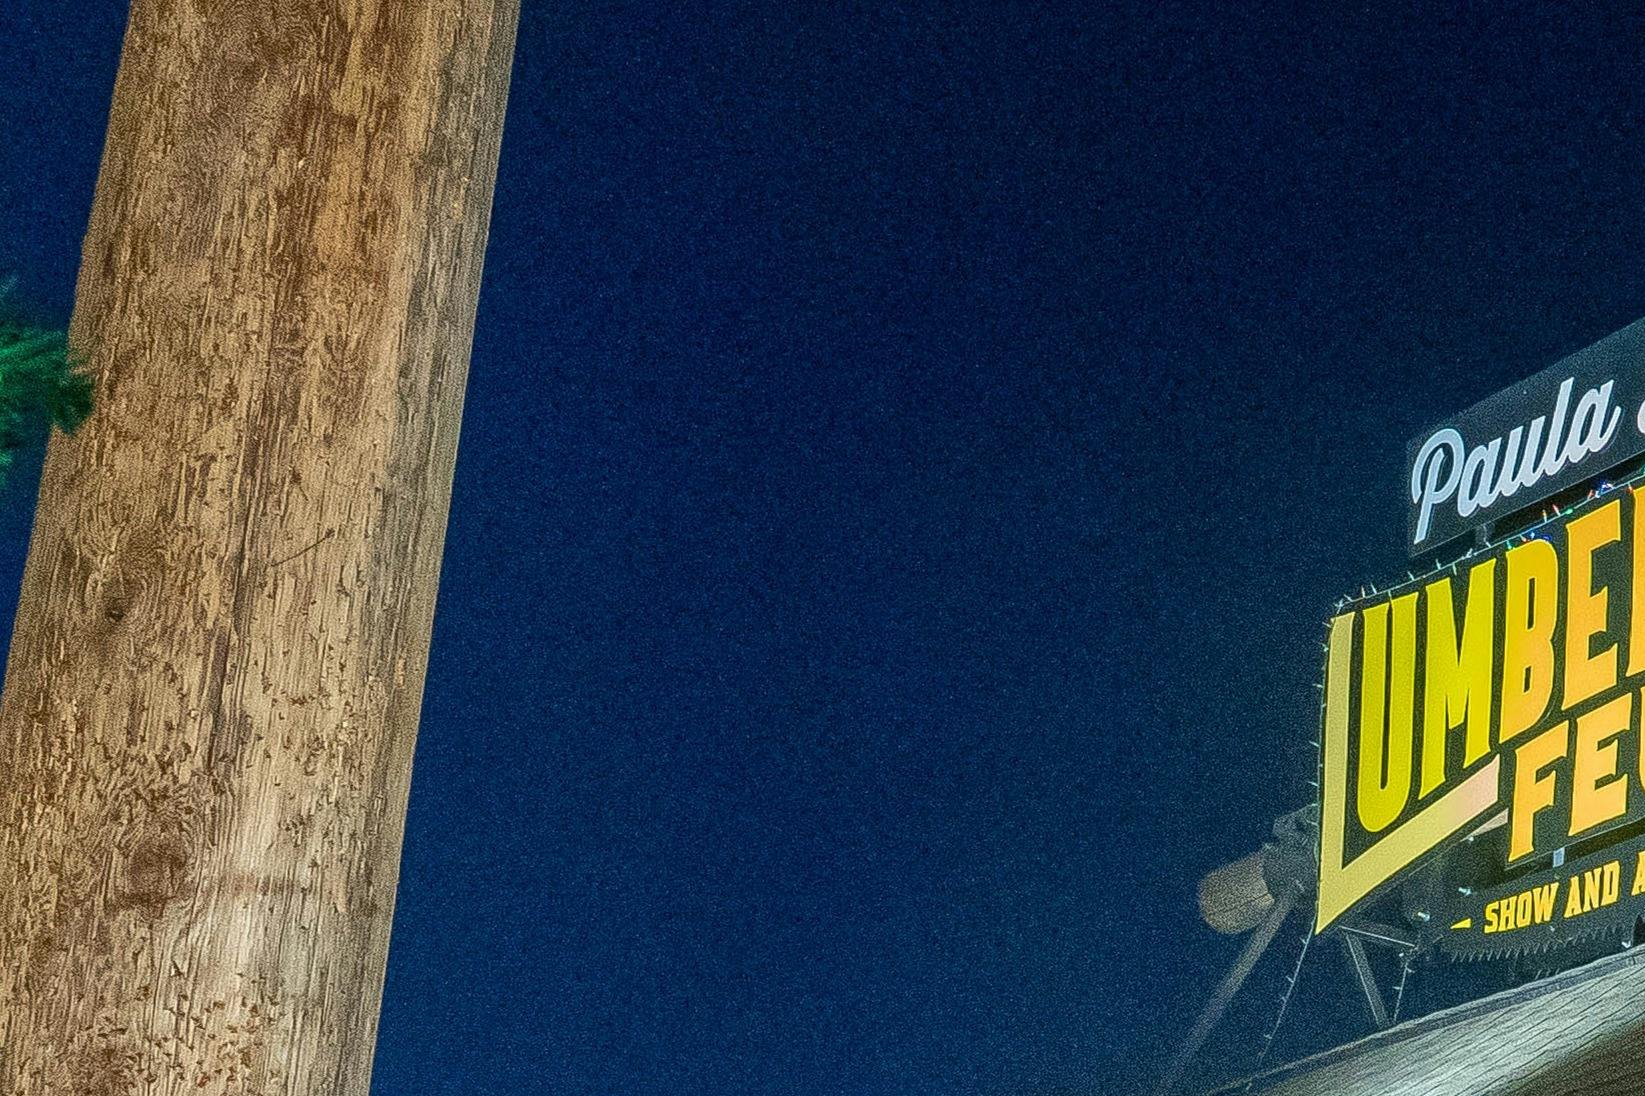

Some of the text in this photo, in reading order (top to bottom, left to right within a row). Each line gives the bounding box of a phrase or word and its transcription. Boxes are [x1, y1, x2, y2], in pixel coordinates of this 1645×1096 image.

[1411, 377, 1621, 545] Paula
[1483, 881, 1561, 934] SHOW
[1563, 860, 1621, 918] AND
